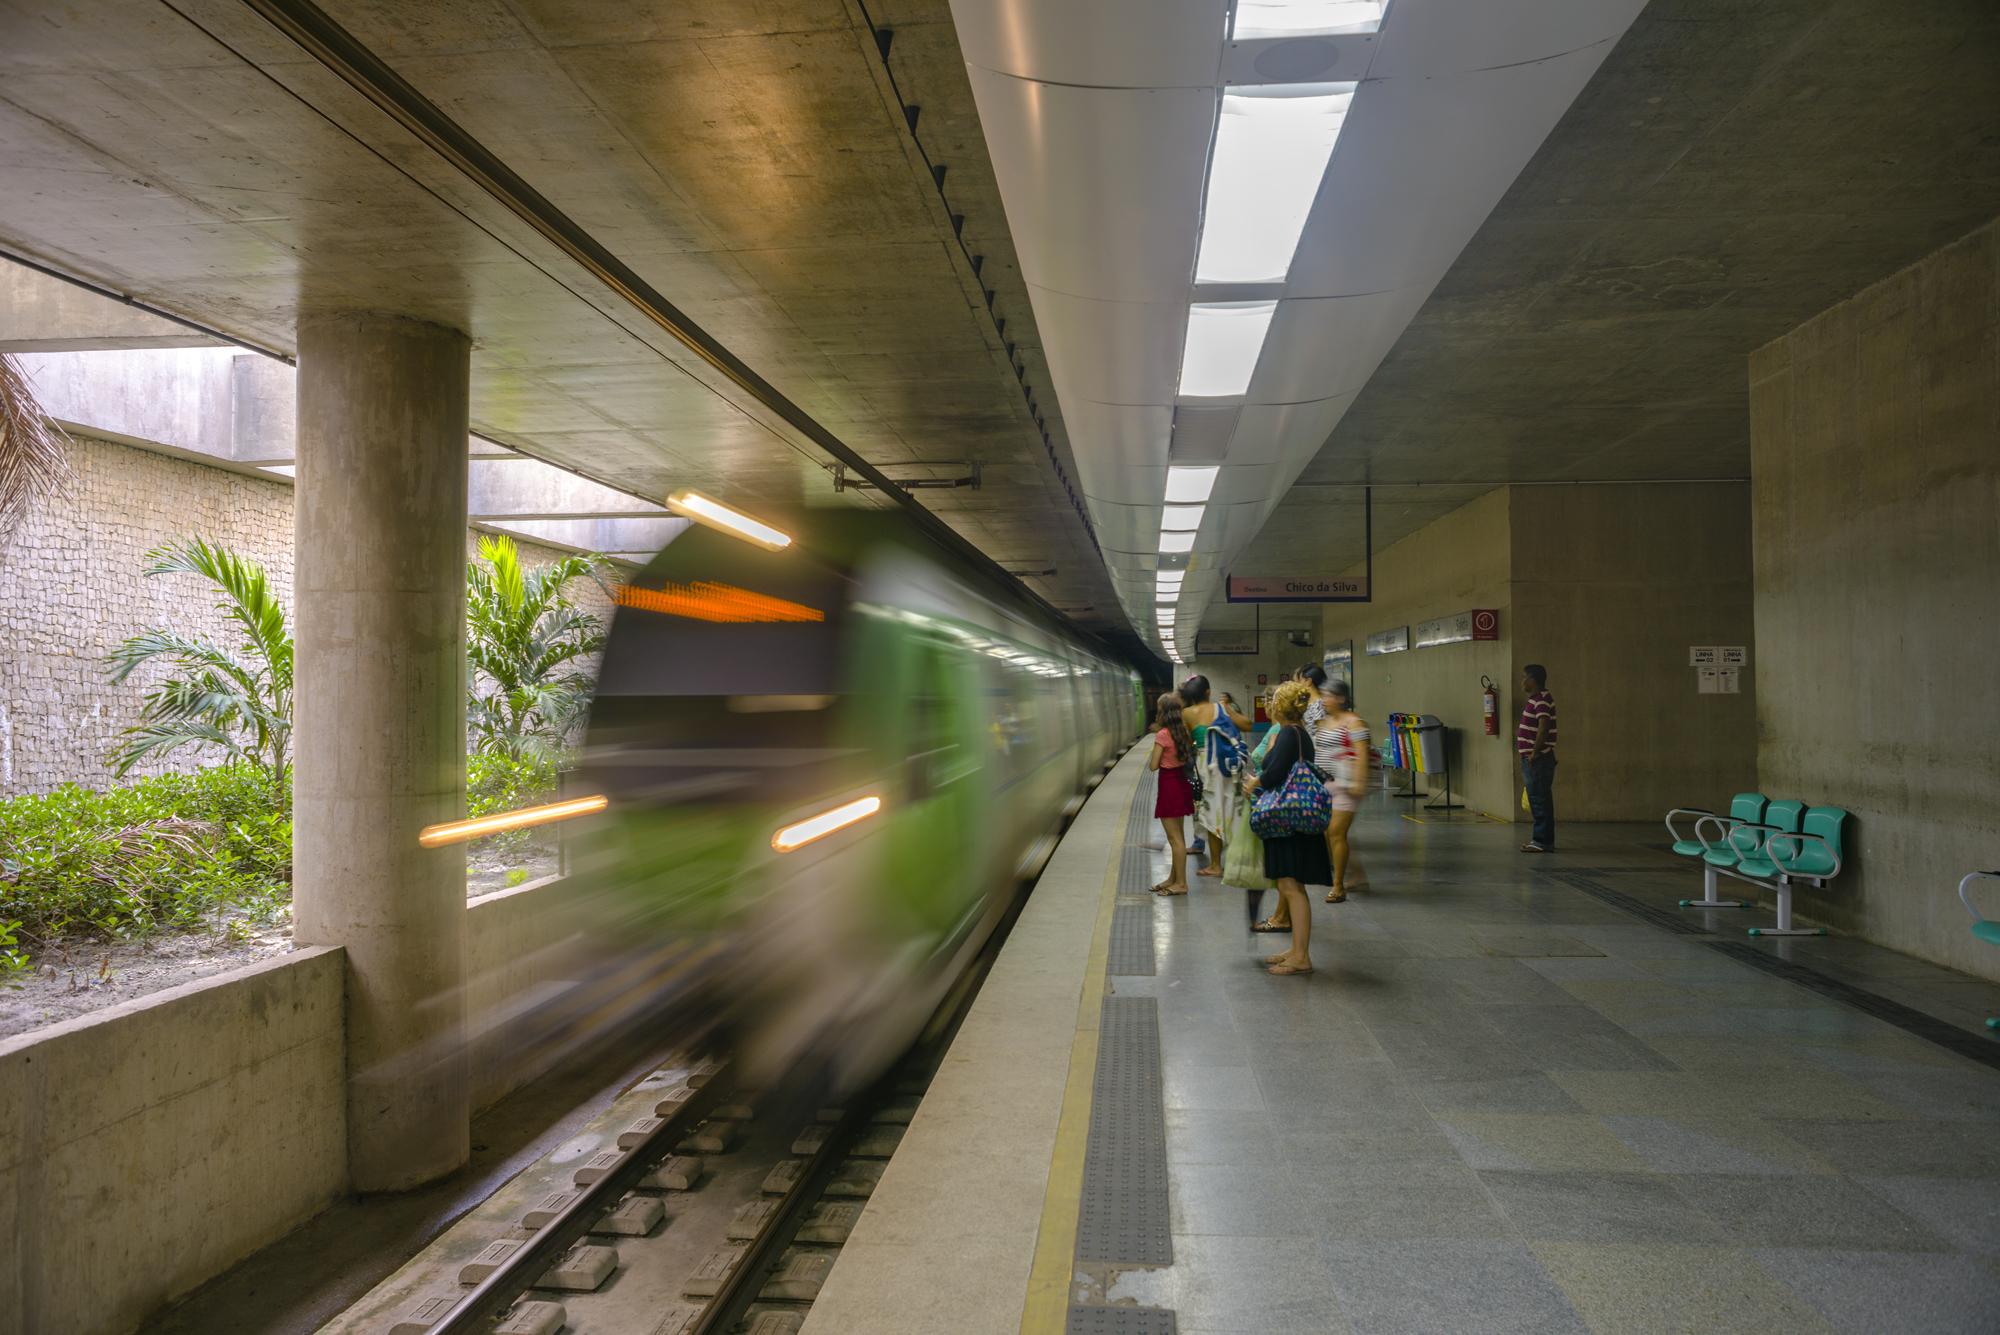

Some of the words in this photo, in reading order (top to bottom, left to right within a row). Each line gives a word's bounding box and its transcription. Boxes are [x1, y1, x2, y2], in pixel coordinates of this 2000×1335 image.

[1286, 582, 1314, 592] Chico
[1316, 582, 1330, 592] da
[1332, 582, 1358, 592] Silva
